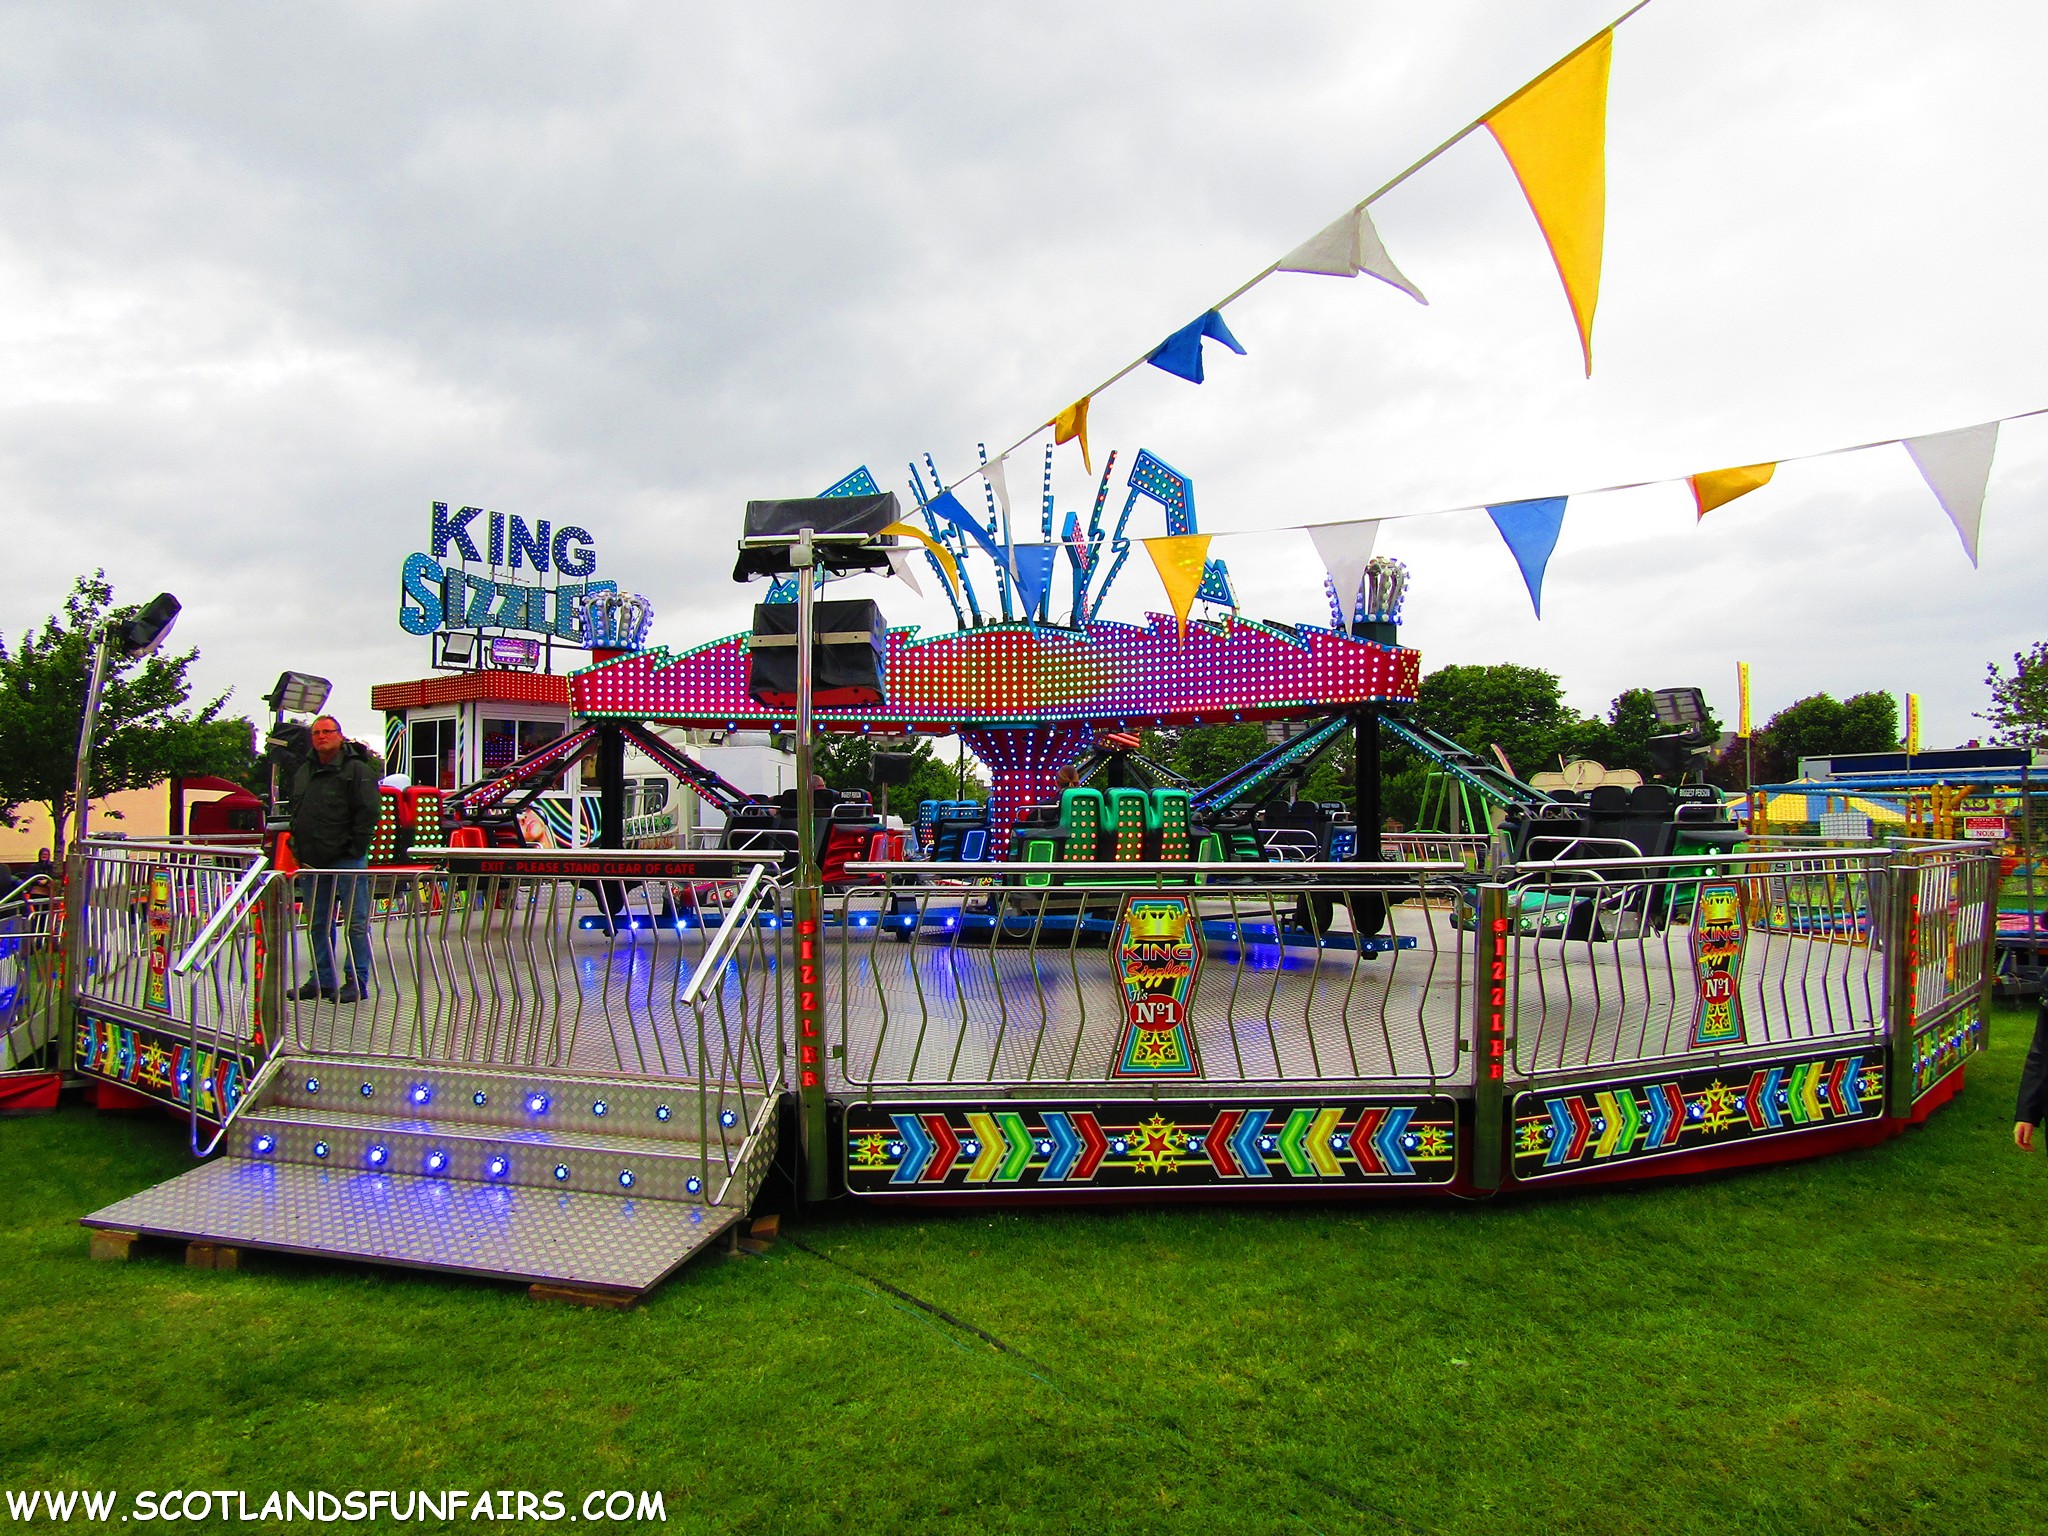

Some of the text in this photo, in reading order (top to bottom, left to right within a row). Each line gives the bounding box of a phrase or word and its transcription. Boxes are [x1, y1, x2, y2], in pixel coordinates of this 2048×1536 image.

[430, 500, 597, 578] KING
[480, 861, 505, 872] EXIT
[516, 861, 560, 873] PLEASE
[562, 862, 601, 874] STAND
[603, 863, 642, 875] CLEAR
[645, 863, 661, 875] OF
[664, 863, 696, 875] GATE
[1698, 924, 1742, 943] KING
[1121, 942, 1194, 961] KING
[1123, 959, 1191, 989] Sizzler
[797, 920, 818, 1087] SIZZLER
[1129, 987, 1149, 1003] It's
[1489, 918, 1508, 1079] SIZZLER
